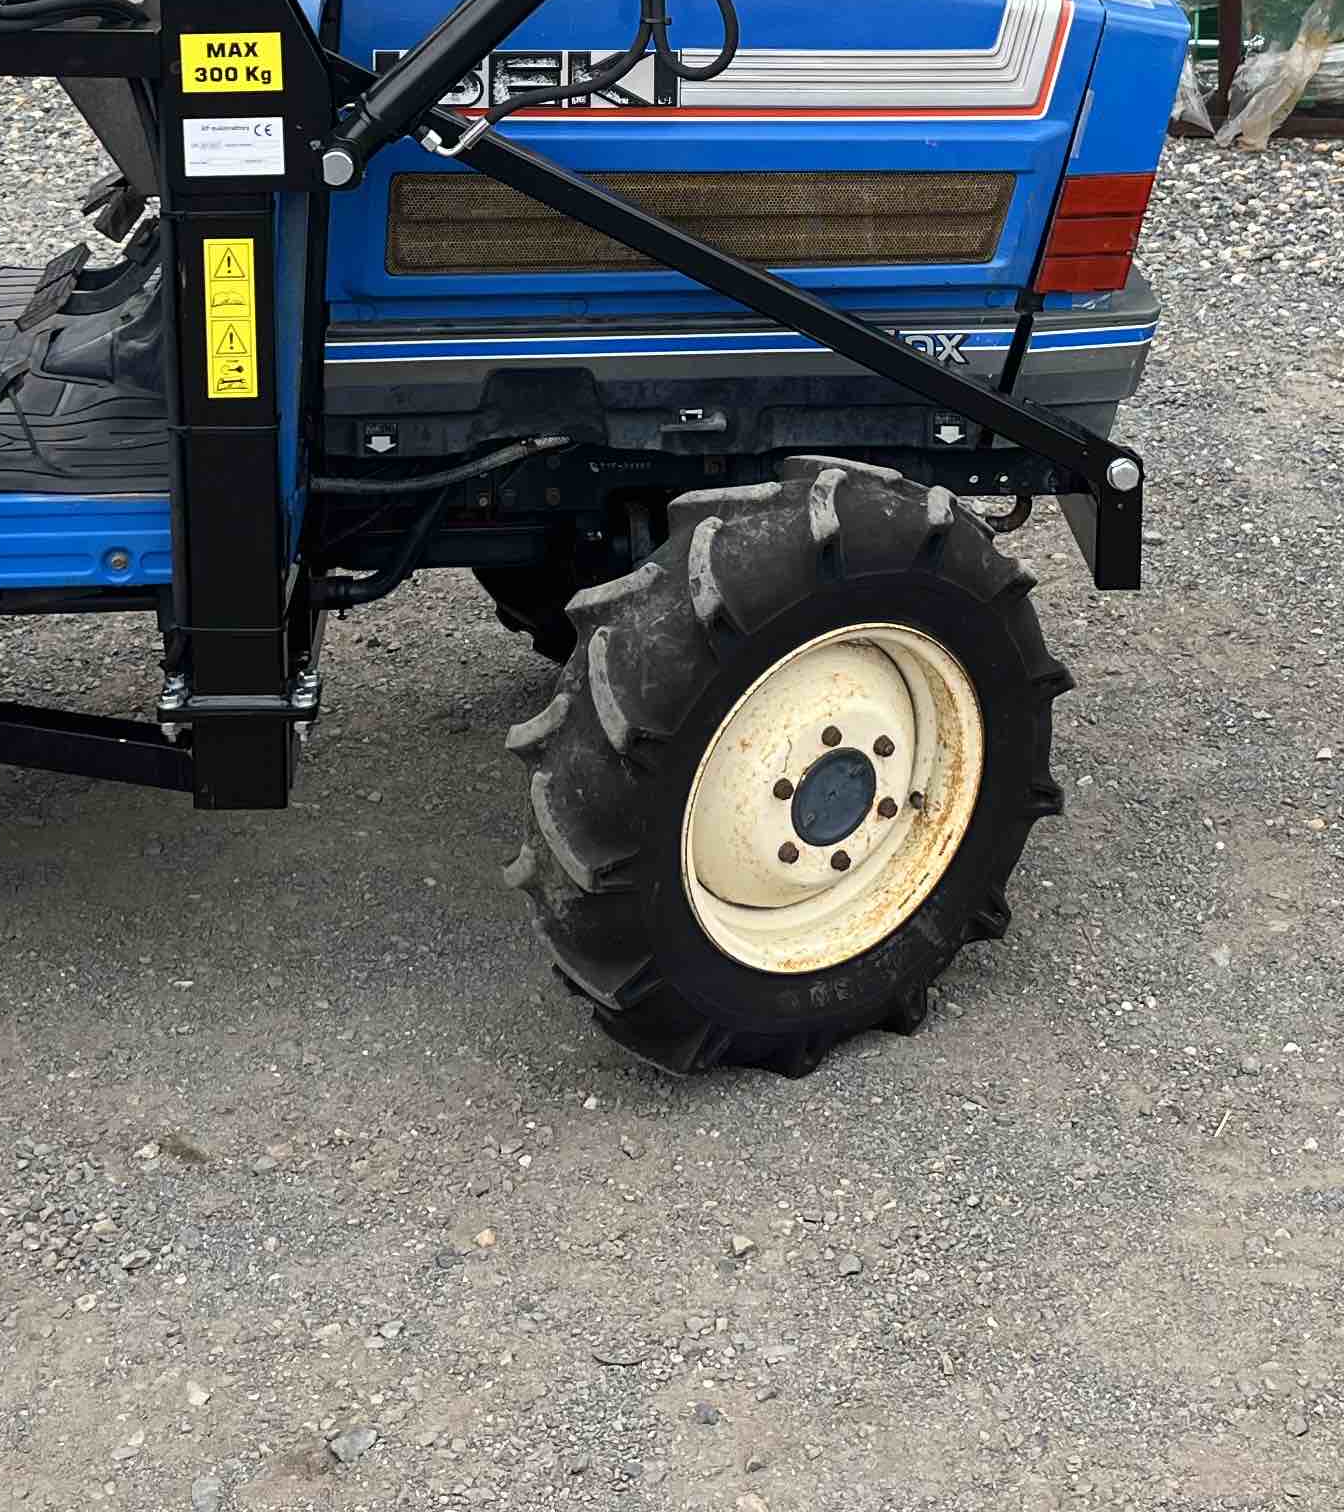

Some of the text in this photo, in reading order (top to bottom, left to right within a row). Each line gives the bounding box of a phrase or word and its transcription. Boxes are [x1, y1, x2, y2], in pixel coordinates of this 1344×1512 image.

[206, 41, 259, 59] MAX
[194, 65, 273, 85] 300 Kg
